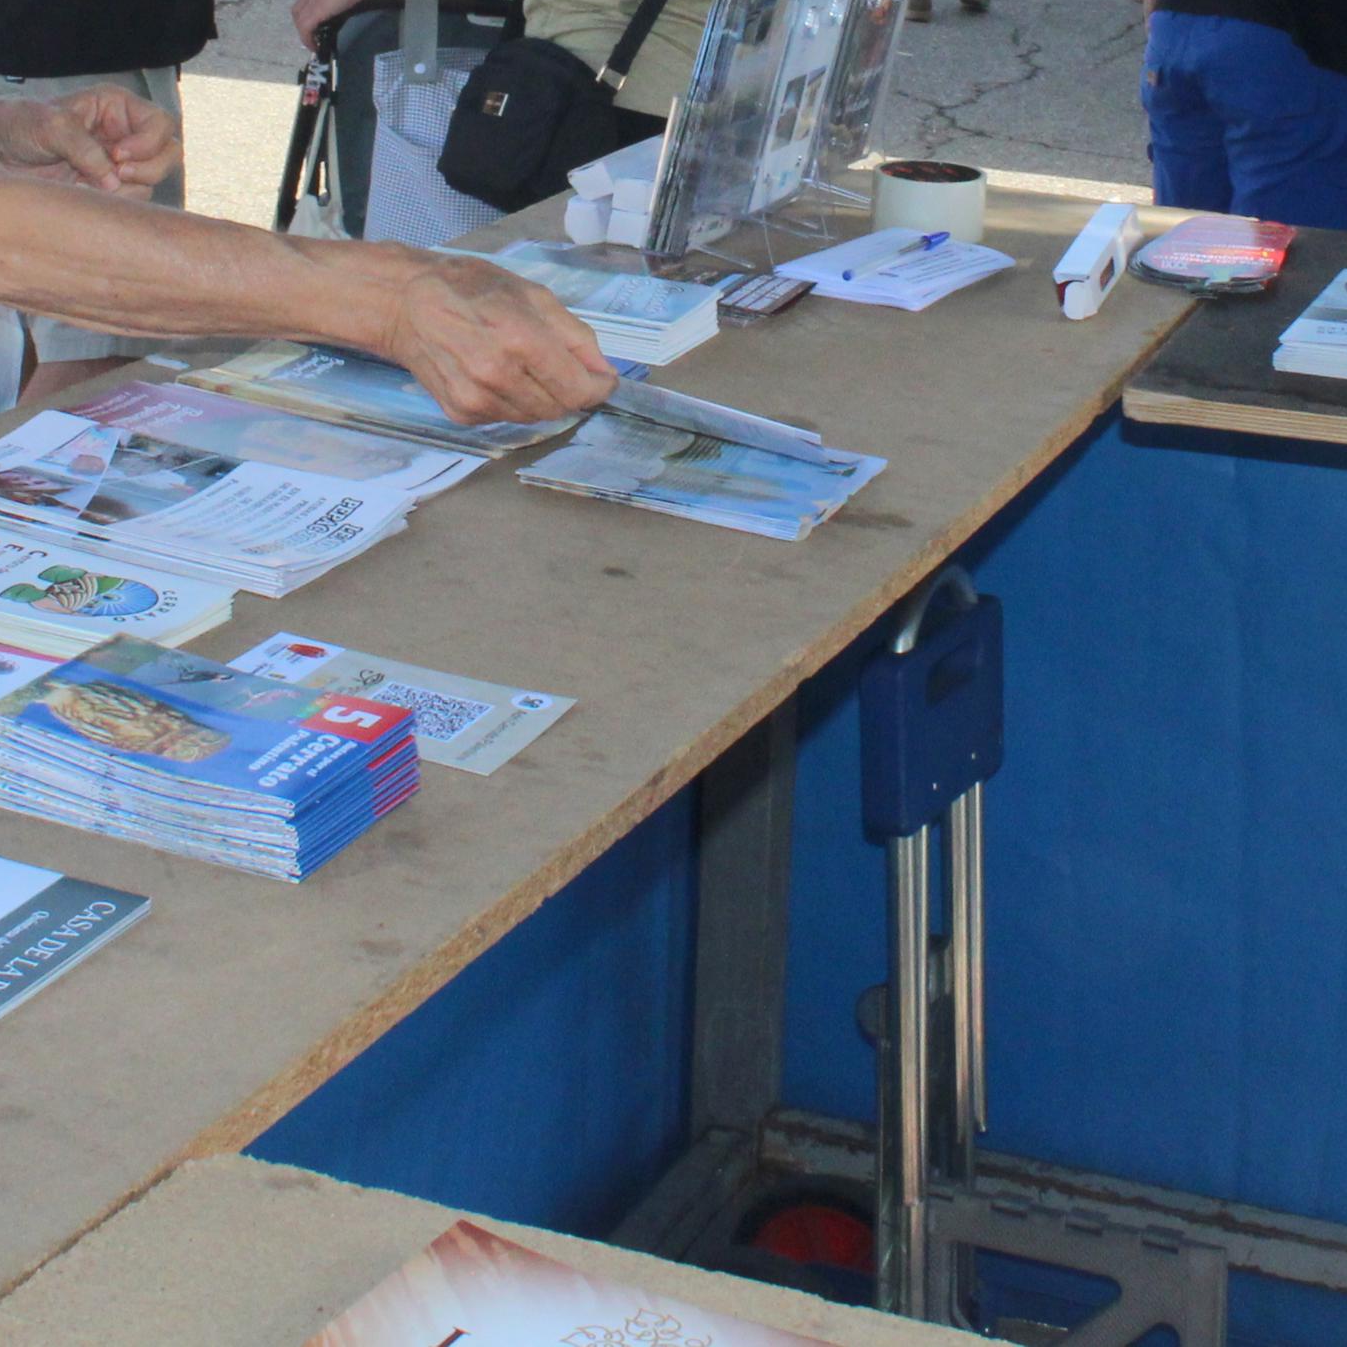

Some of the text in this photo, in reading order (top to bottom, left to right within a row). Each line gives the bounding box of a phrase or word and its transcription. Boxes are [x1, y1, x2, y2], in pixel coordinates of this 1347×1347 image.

[323, 705, 383, 729] 5
[248, 729, 311, 771] Palentino
[257, 734, 342, 788] Cerrato
[52, 901, 116, 939] CASA
[24, 936, 68, 960] DE
